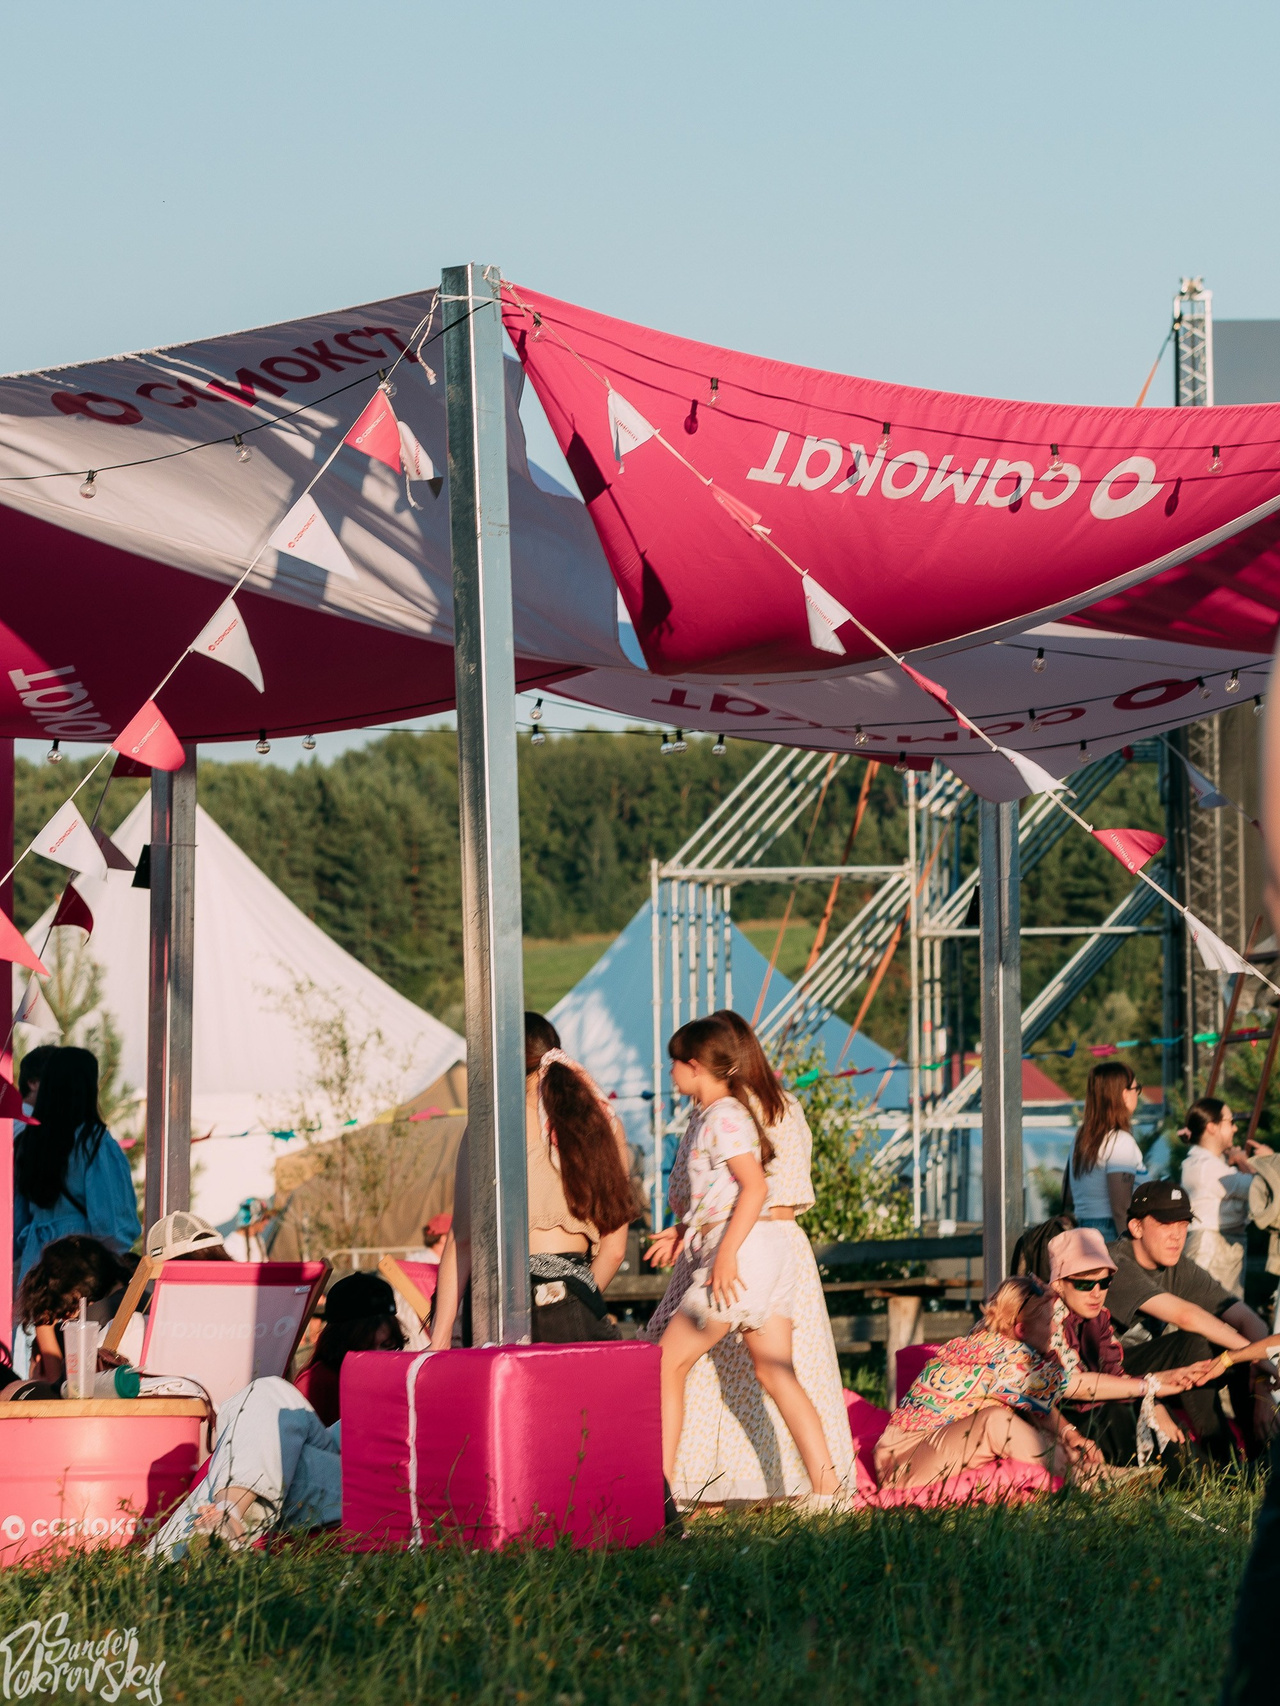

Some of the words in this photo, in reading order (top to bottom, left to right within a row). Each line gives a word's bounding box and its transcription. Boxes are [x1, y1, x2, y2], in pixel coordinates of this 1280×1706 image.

[746, 432, 1081, 508] самокат
[8, 664, 118, 740] окат
[651, 687, 1086, 744] самат
